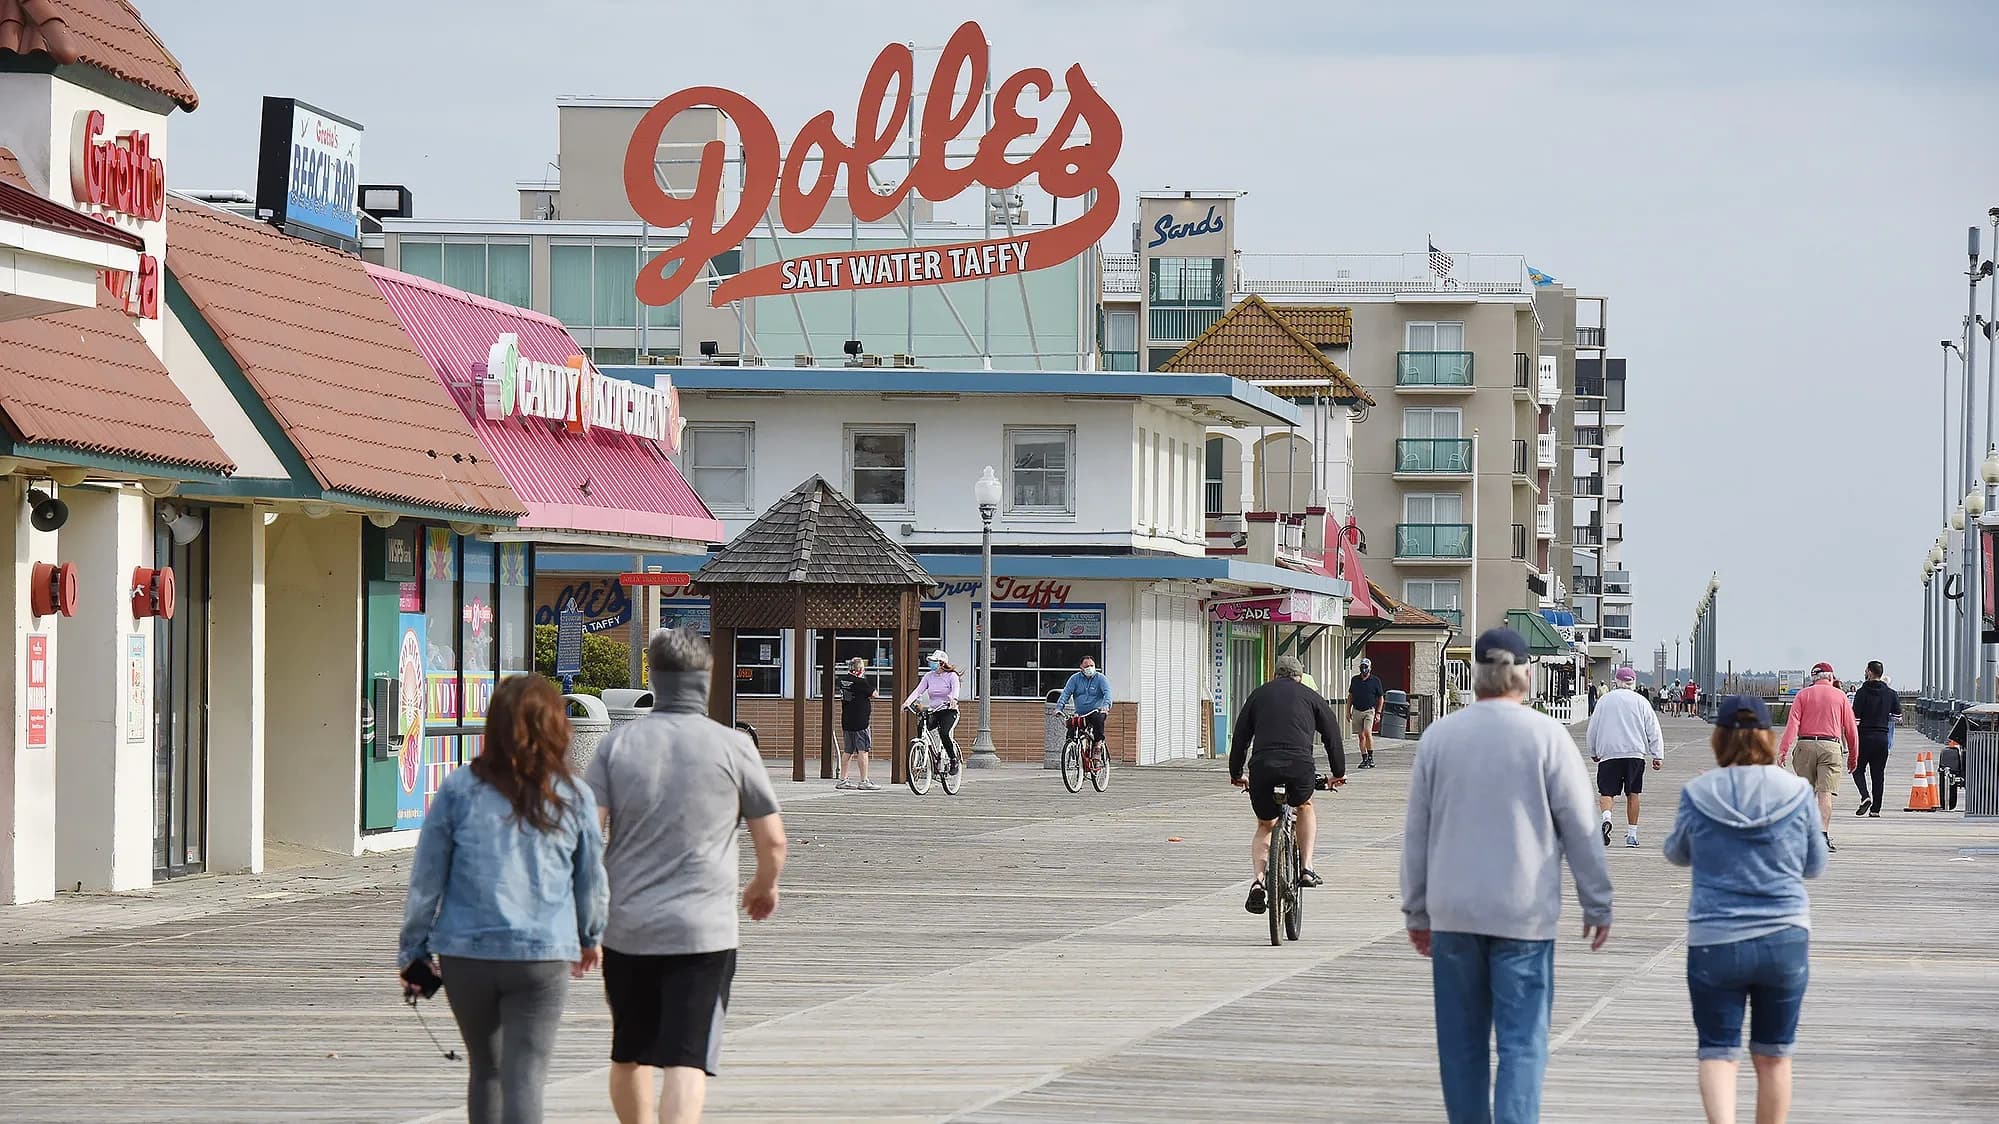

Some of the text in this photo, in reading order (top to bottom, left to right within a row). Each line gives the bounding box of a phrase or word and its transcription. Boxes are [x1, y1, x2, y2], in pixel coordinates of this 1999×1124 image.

[78, 109, 165, 222] Grotto
[292, 143, 355, 213] BEACH BAR
[1148, 205, 1224, 249] Sands
[781, 240, 1030, 290] SALT WATER TAFFY
[517, 356, 670, 442] CANDY KITCHEN
[990, 576, 1072, 609] Taffy
[589, 615, 621, 632] TAFFY
